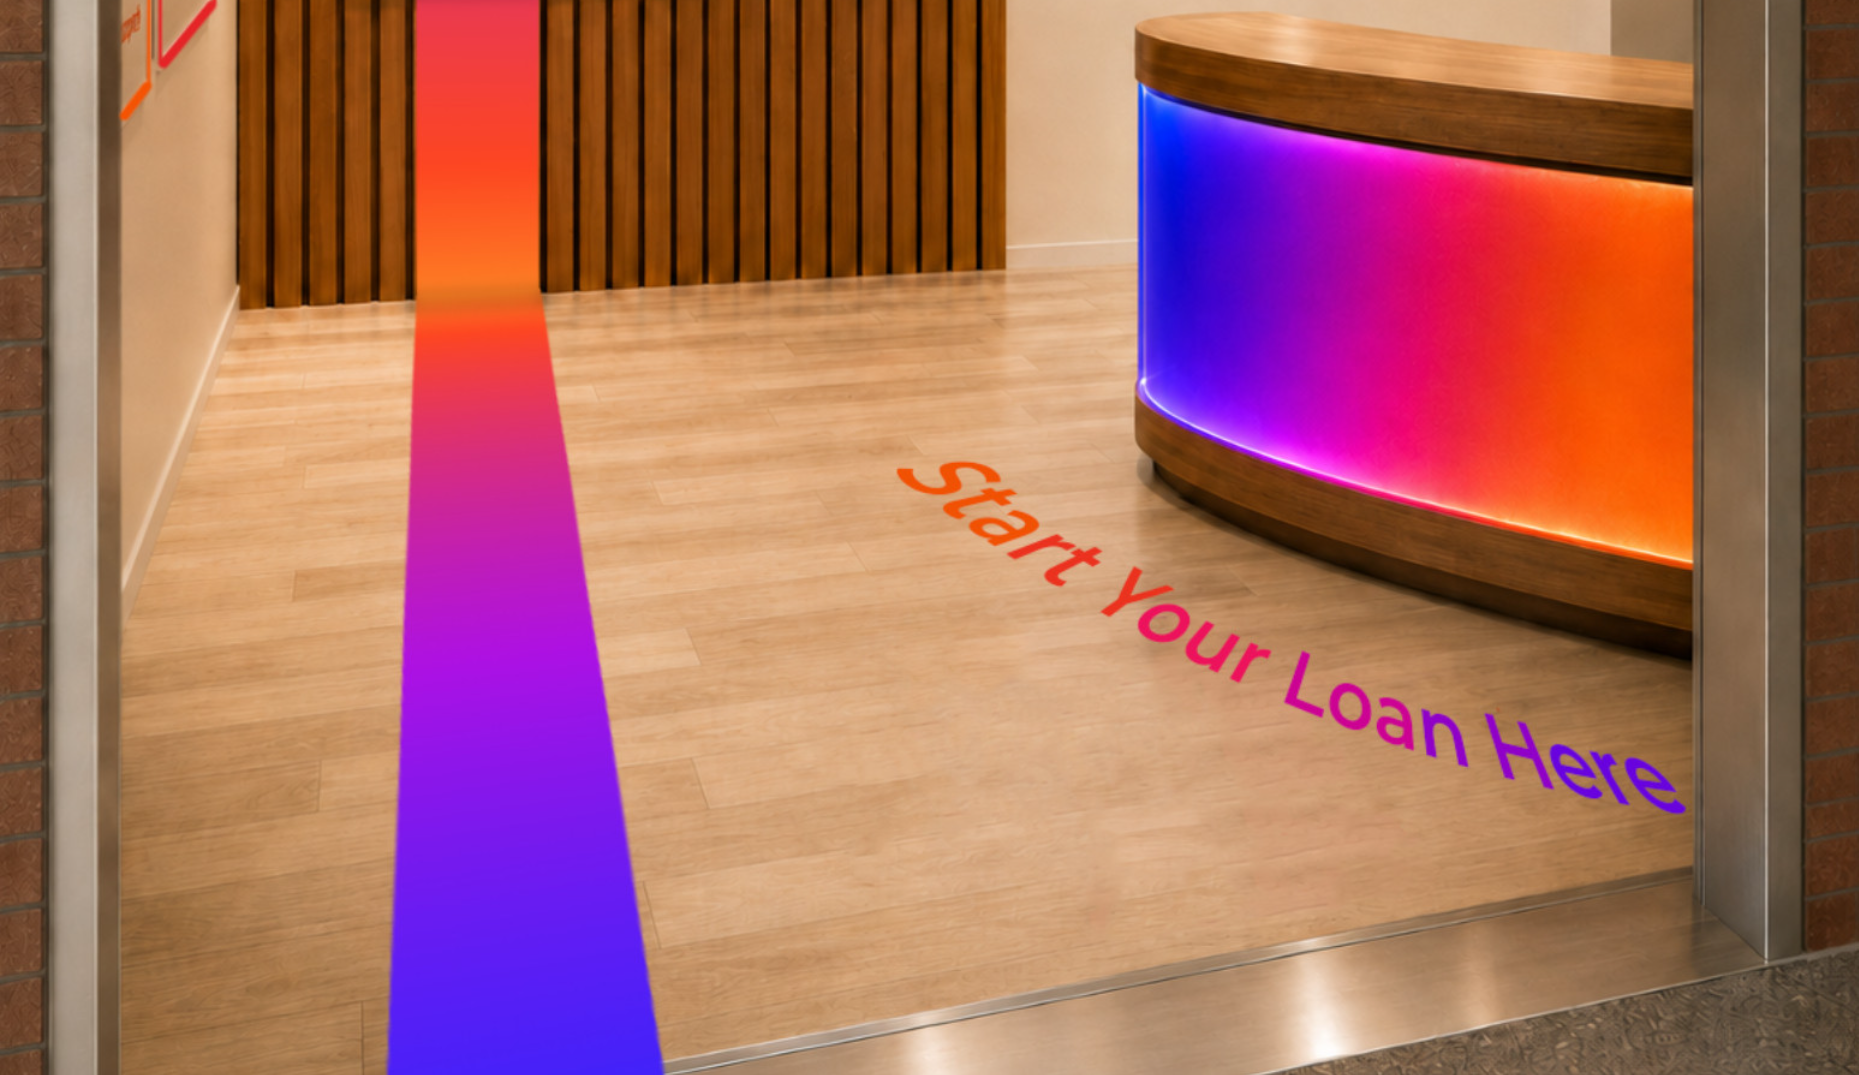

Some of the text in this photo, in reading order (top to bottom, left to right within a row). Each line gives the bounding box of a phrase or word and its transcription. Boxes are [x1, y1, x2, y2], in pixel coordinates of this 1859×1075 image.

[896, 461, 1686, 815] Start Your Loan Here
